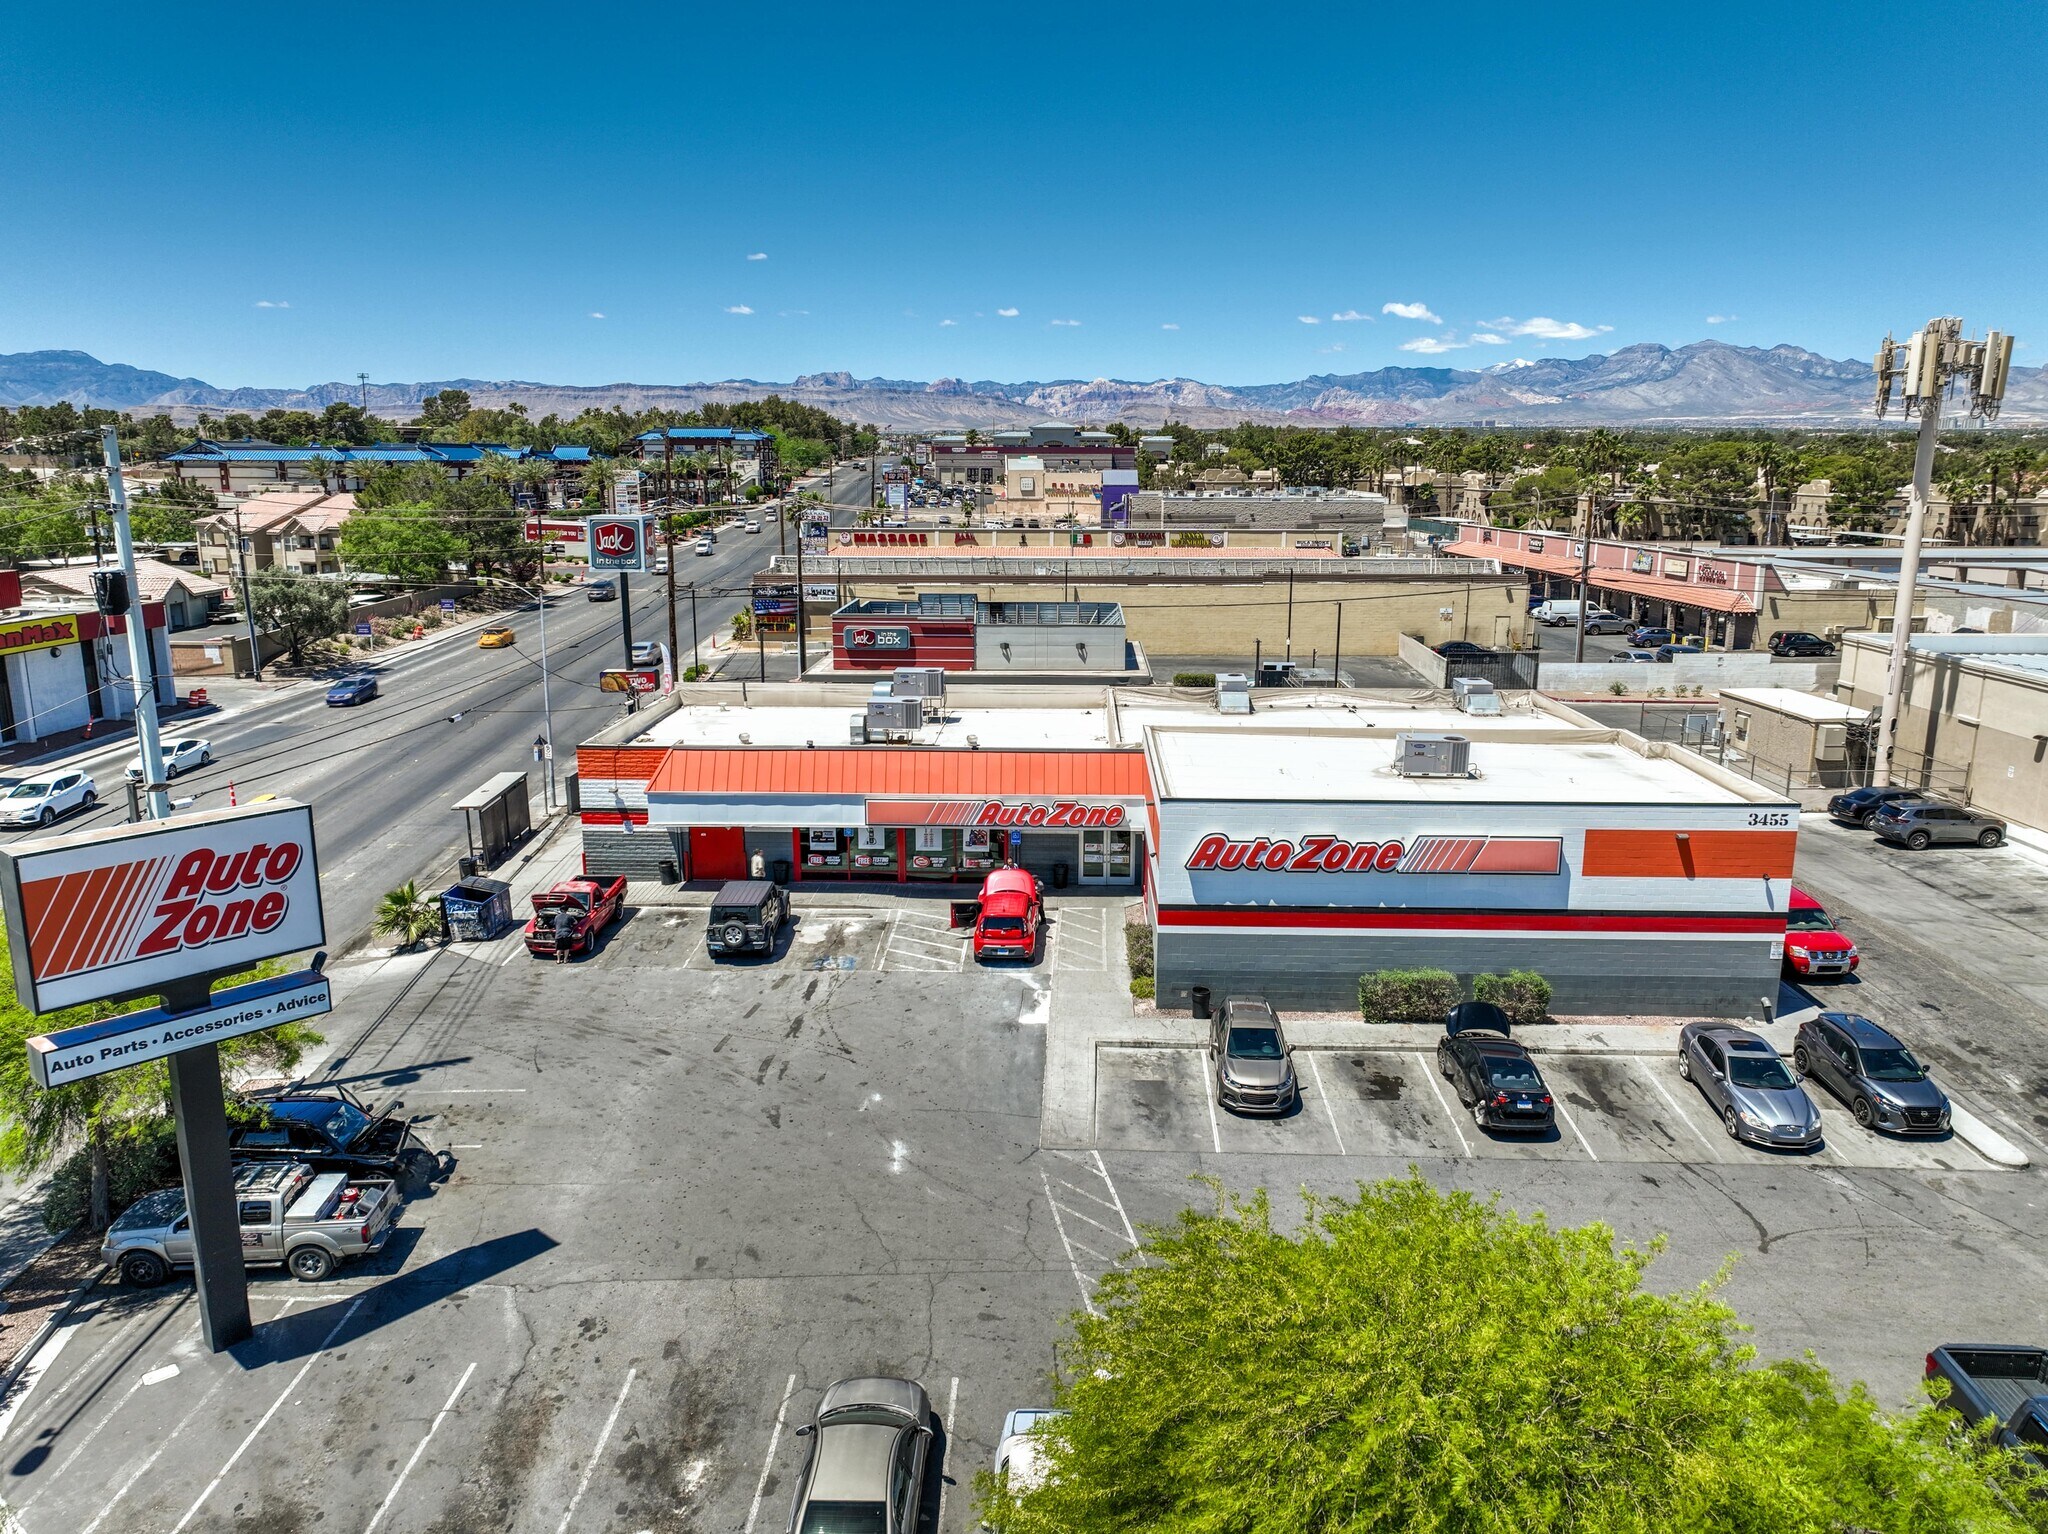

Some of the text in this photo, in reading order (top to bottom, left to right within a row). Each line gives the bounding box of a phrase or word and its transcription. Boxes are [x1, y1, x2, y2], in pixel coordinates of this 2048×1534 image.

[597, 527, 634, 551] Jack
[854, 533, 927, 543] MASSAGE
[606, 557, 619, 565] the
[621, 557, 637, 565] box
[853, 631, 901, 645] Jack box
[976, 801, 1125, 826] AutoZone
[1748, 813, 1789, 826] 3455
[1187, 834, 1404, 872] AutoZone
[162, 842, 302, 901] Auto
[136, 891, 289, 957] Zone
[51, 991, 327, 1074] Auto Parts Accessories Advice
